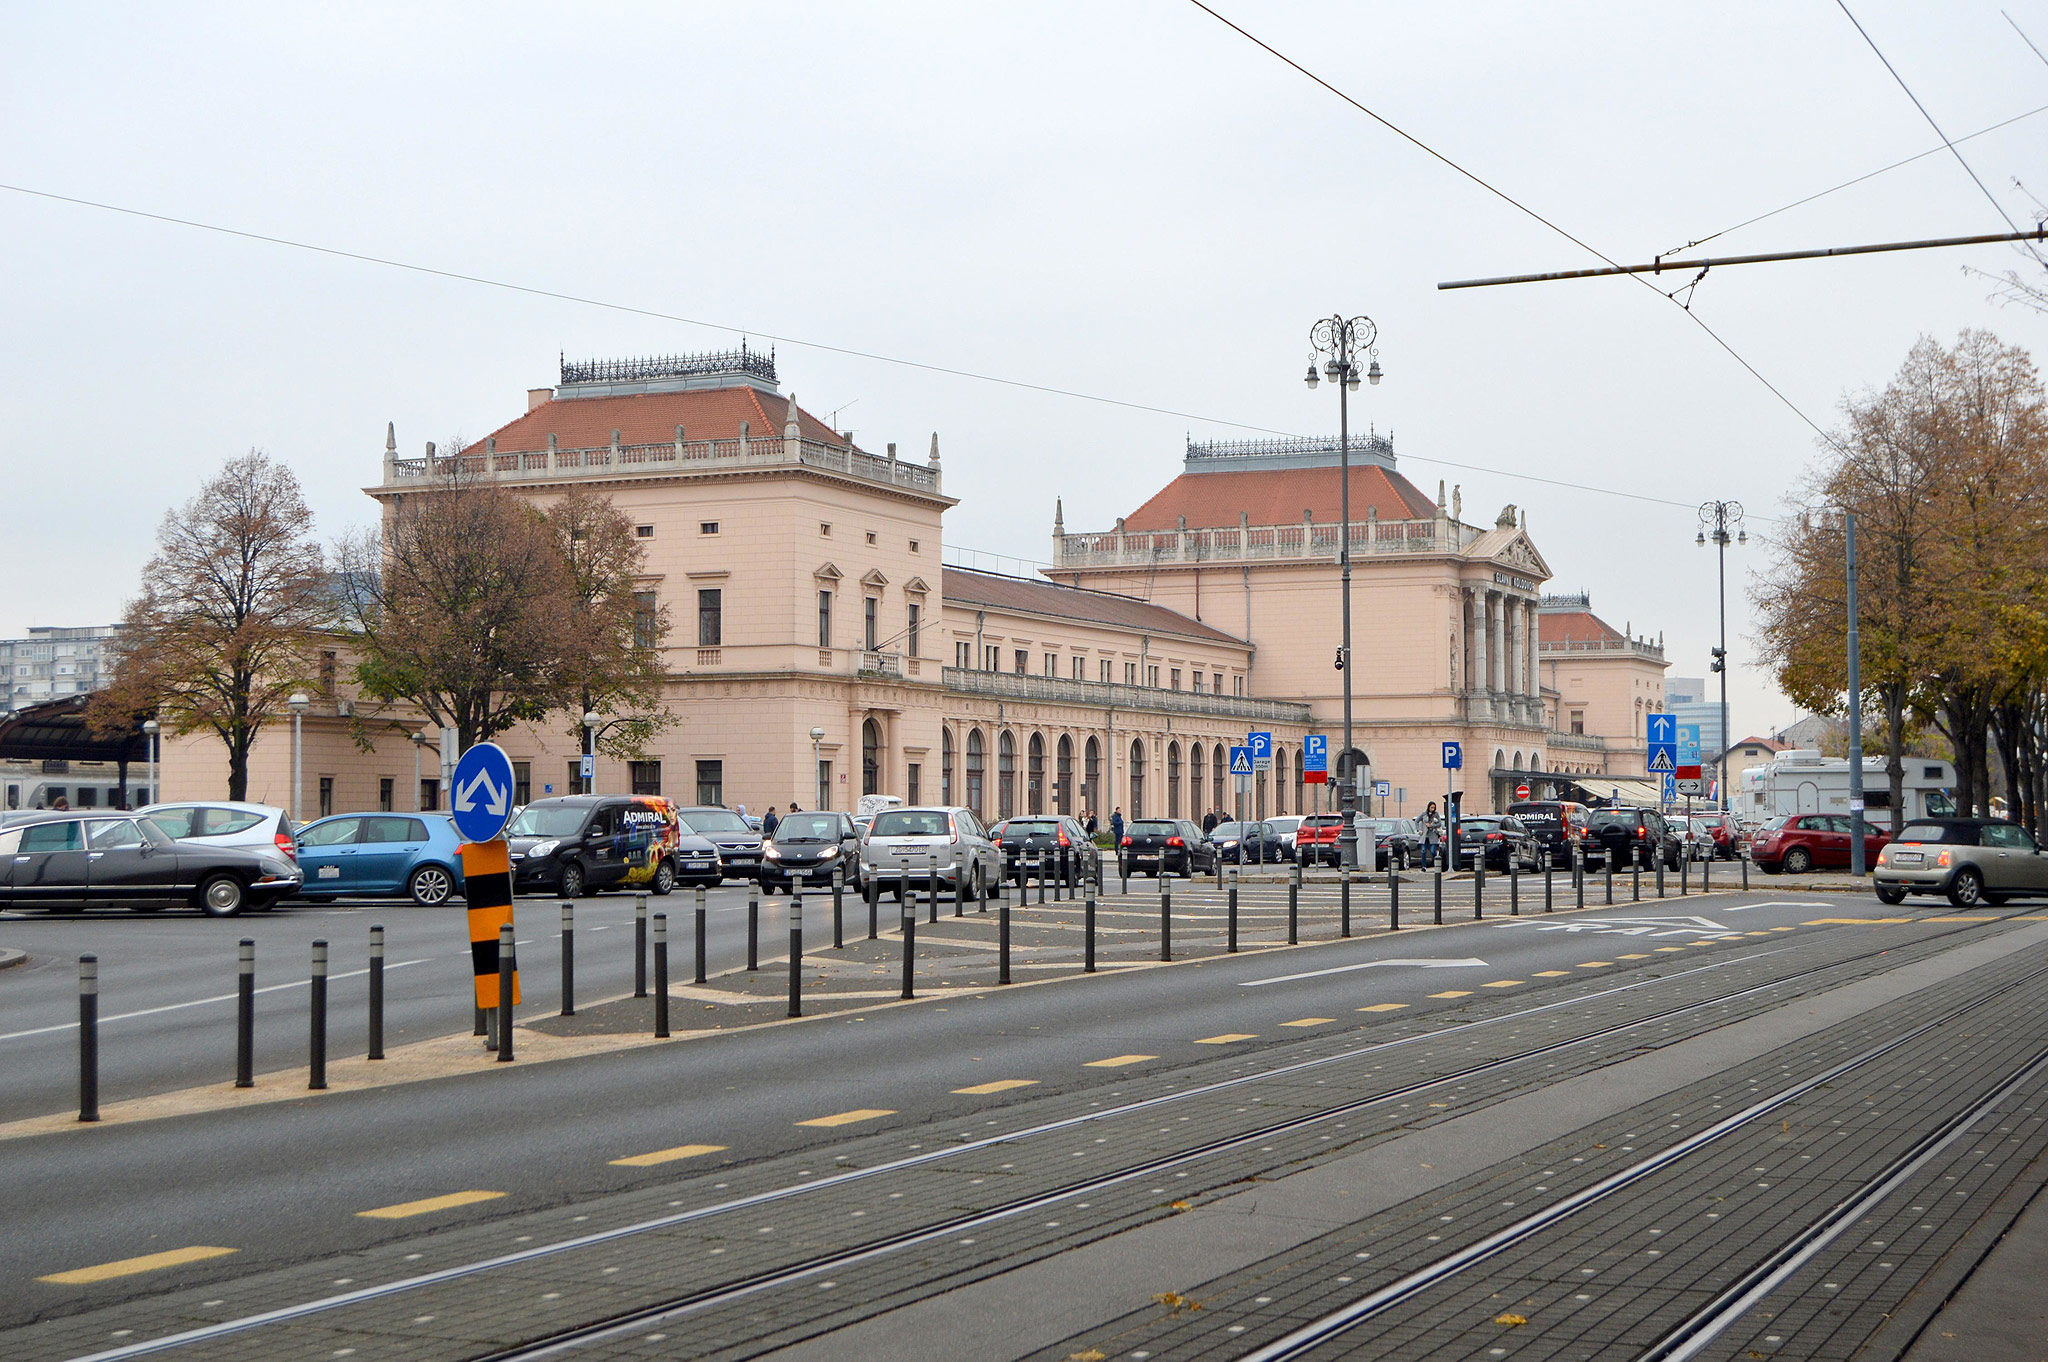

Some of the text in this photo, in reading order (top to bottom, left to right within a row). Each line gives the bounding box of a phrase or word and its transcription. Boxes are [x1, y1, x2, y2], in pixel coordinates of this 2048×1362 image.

[1254, 740, 1265, 756] P
[1310, 737, 1321, 754] P
[1445, 747, 1457, 764] P
[40, 785, 46, 796] 2
[623, 810, 667, 825] ADMIRAL
[1514, 812, 1557, 821] ADMIRAL
